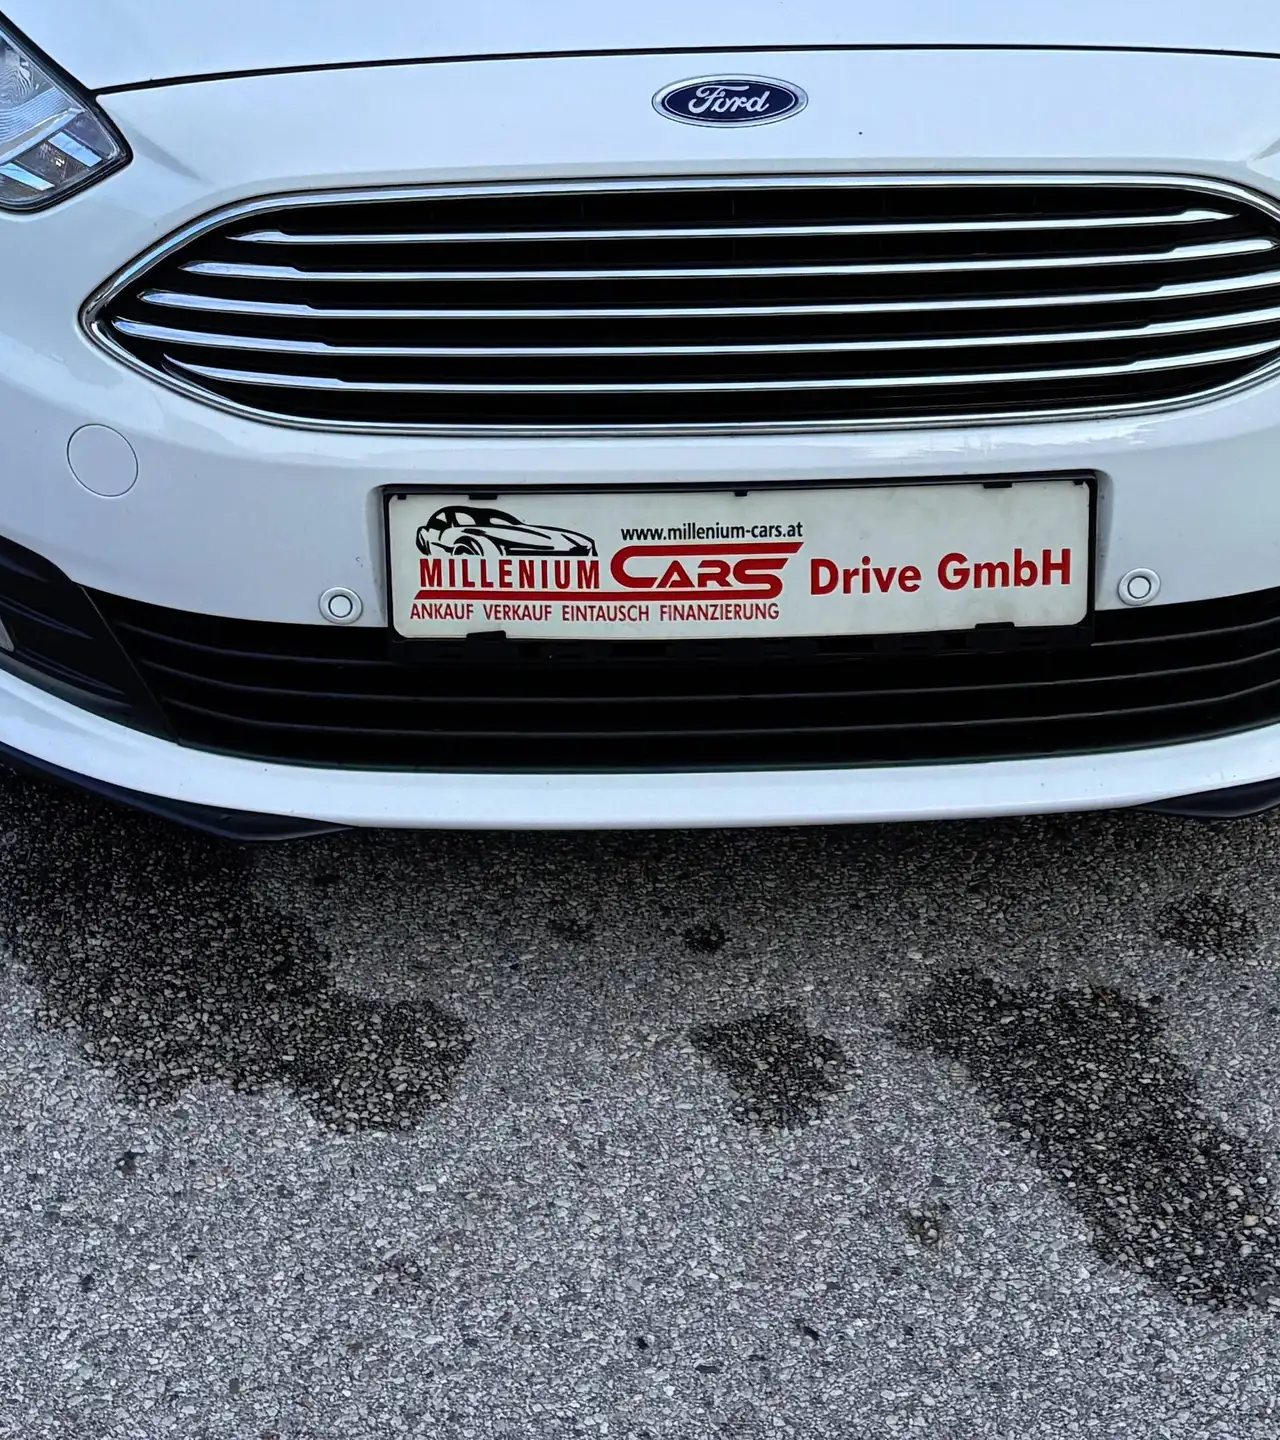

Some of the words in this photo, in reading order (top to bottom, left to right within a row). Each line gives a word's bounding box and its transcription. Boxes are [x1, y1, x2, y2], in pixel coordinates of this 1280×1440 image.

[688, 85, 770, 114] Ford
[621, 522, 803, 541] www.millenium-cars.at
[420, 558, 599, 589] MILLENIUM
[610, 542, 804, 599] CARS
[810, 556, 922, 595] Drive
[937, 548, 1071, 590] GmbH
[410, 603, 474, 621] ANKAUF
[483, 603, 553, 621] VERKAUF
[562, 604, 650, 622] EINTAUSCH
[660, 602, 780, 621] FINANZIERUNG
